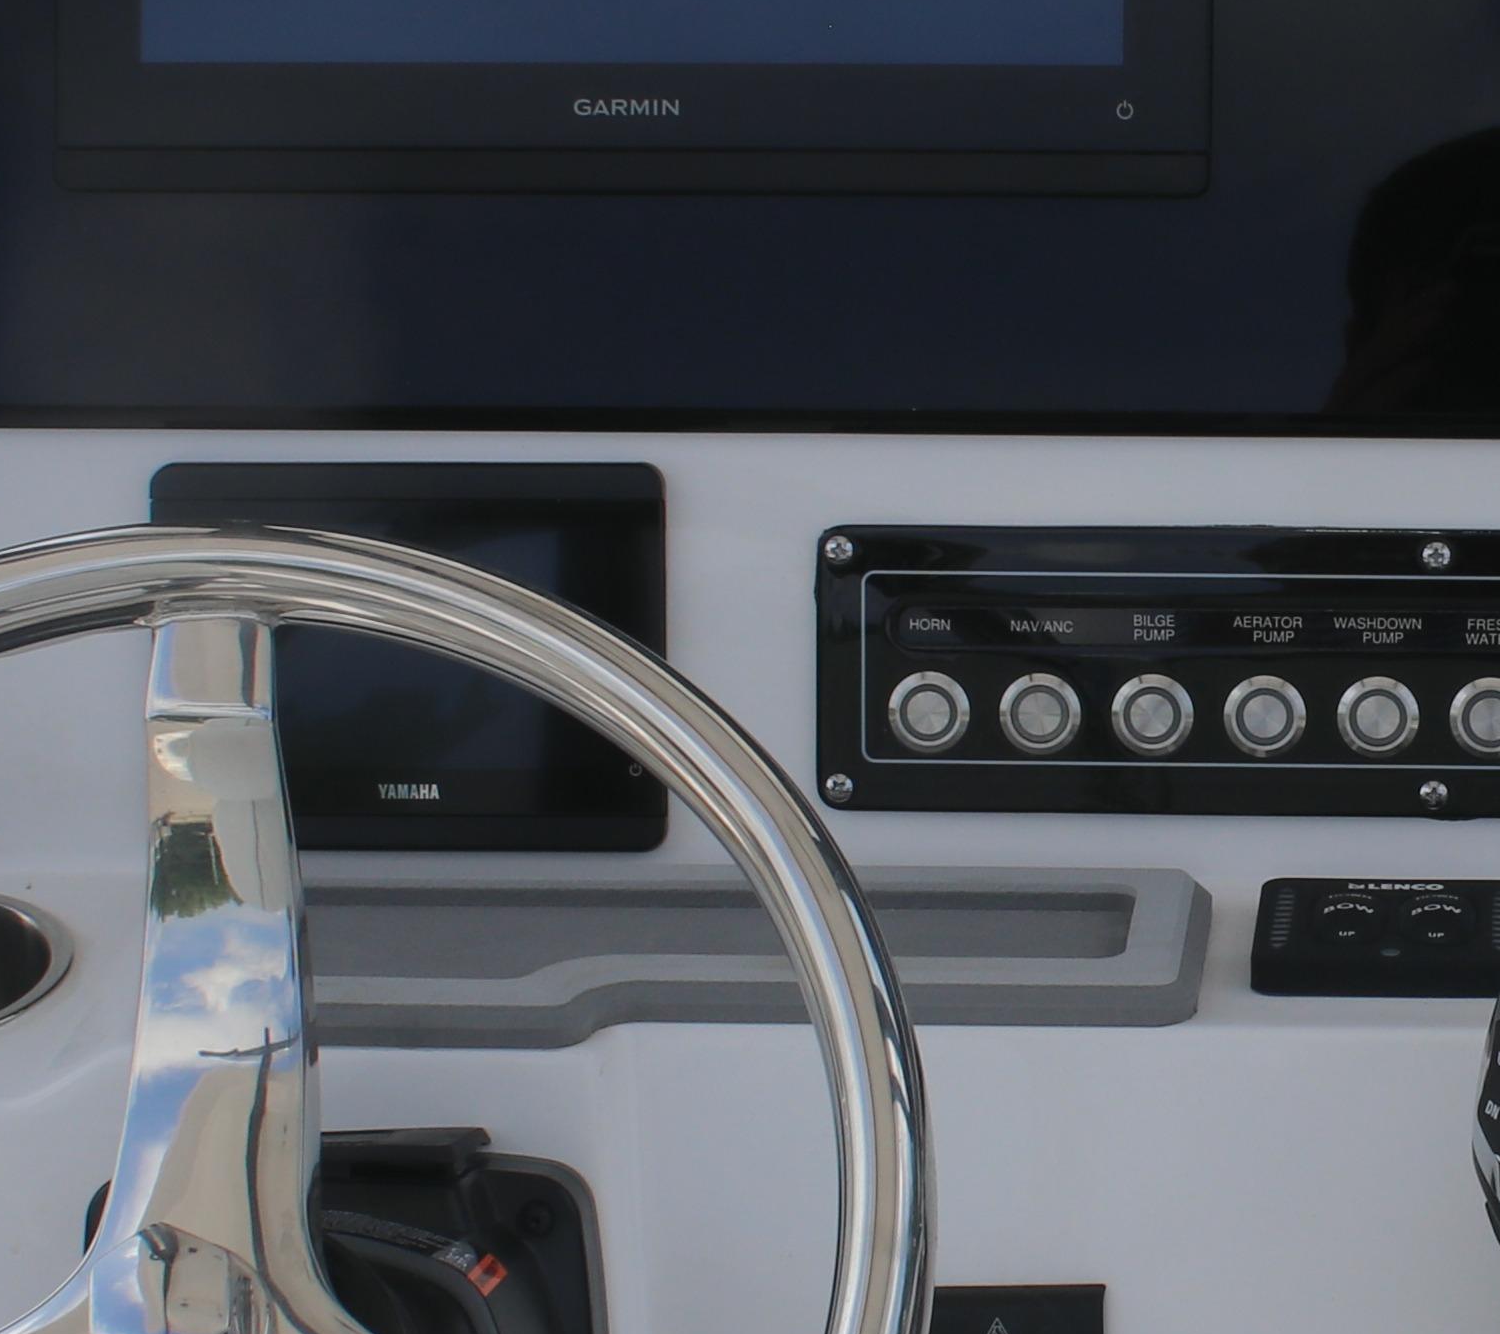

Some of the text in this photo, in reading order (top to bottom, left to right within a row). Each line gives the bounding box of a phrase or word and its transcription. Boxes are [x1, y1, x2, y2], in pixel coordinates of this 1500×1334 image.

[573, 98, 680, 116] GARMIN
[909, 618, 951, 632] HORN
[1010, 619, 1074, 634] NAV/ANC
[1133, 614, 1176, 628] BILGE
[1232, 615, 1303, 629] AERATOR
[1333, 616, 1422, 630] WASHDOWN
[1133, 628, 1176, 642] PUMP
[1253, 630, 1295, 643] PUMP
[1362, 631, 1404, 644] PUMP
[378, 783, 440, 800] YAMAHA
[1368, 883, 1445, 891] LENCO
[1324, 902, 1374, 914] BOW
[1411, 904, 1462, 916] BOW
[1484, 1099, 1500, 1120] DN
